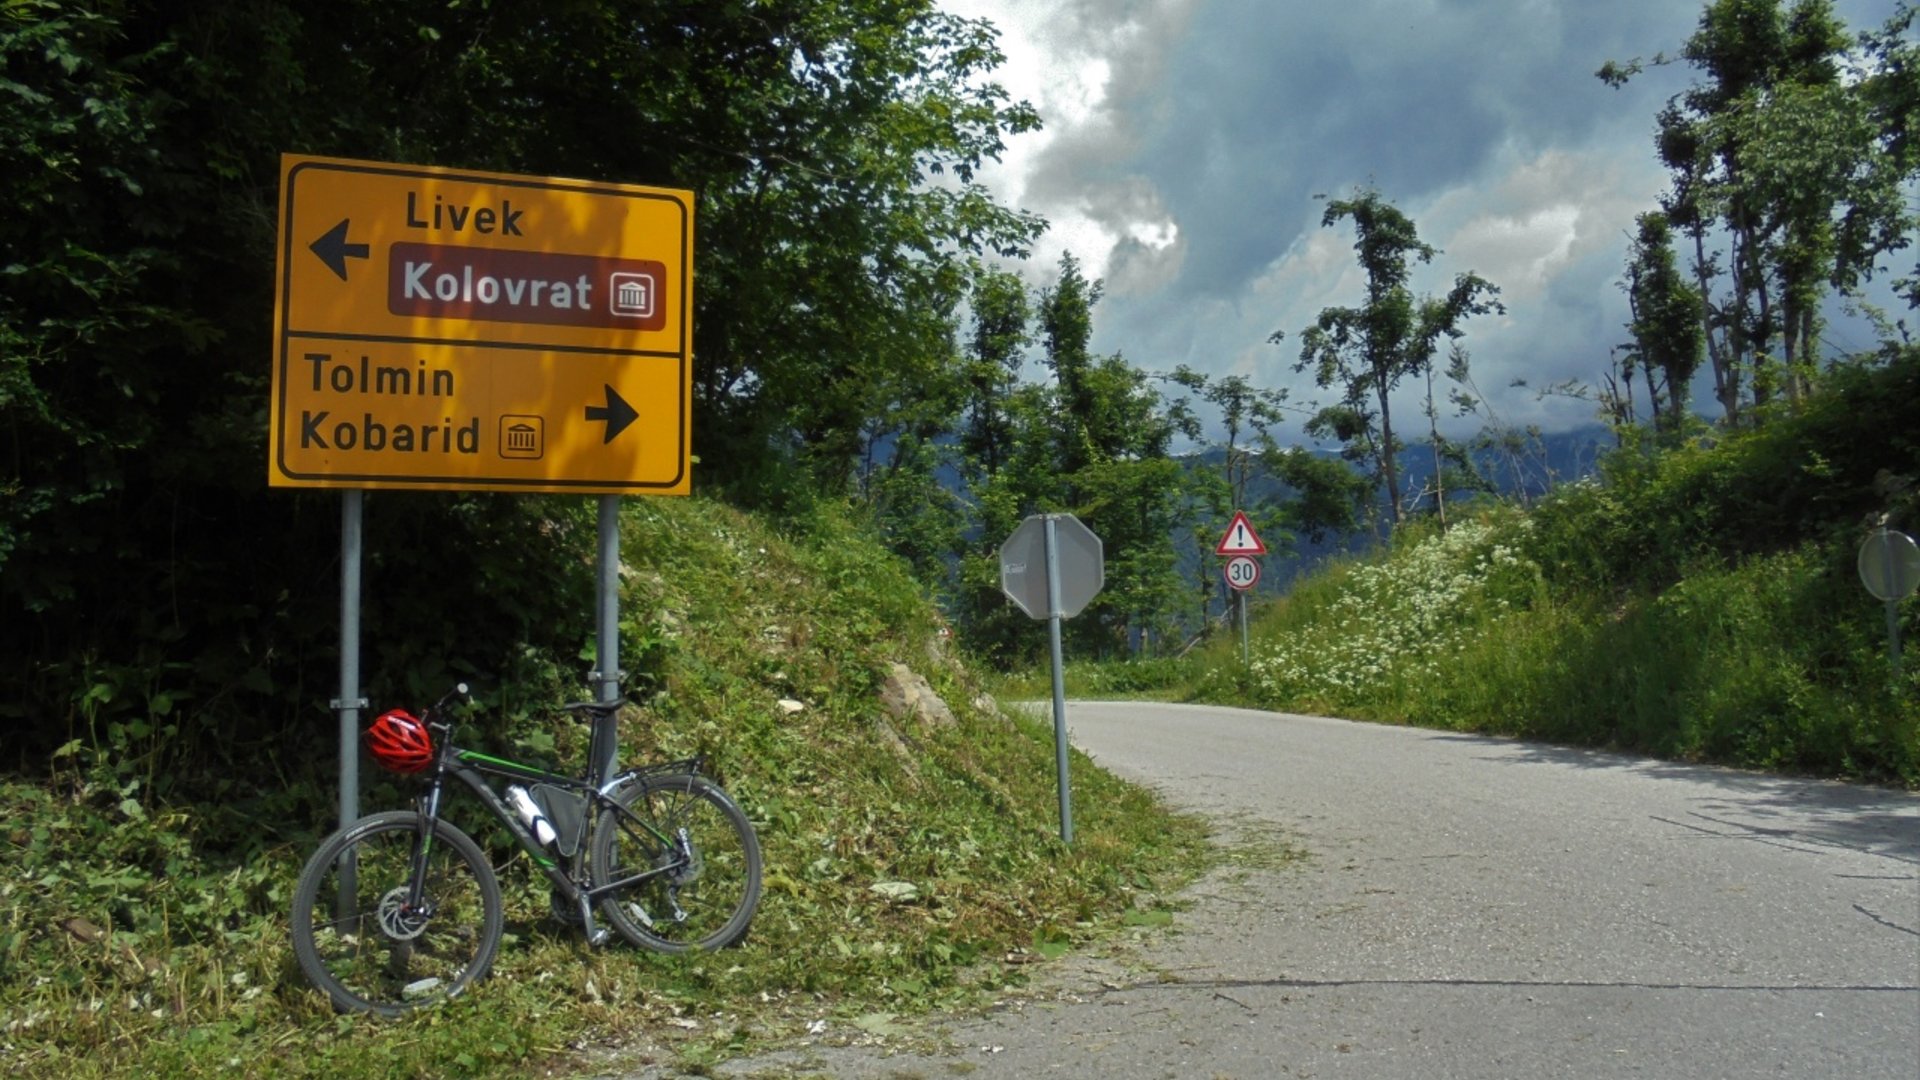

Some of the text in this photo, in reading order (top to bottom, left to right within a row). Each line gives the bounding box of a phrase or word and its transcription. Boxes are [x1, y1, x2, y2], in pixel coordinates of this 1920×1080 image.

[406, 191, 524, 236] Livek
[404, 261, 592, 309] Kolovrat
[304, 353, 454, 396] Tolmin
[301, 410, 480, 454] Kobarid
[1231, 563, 1252, 581] 30
